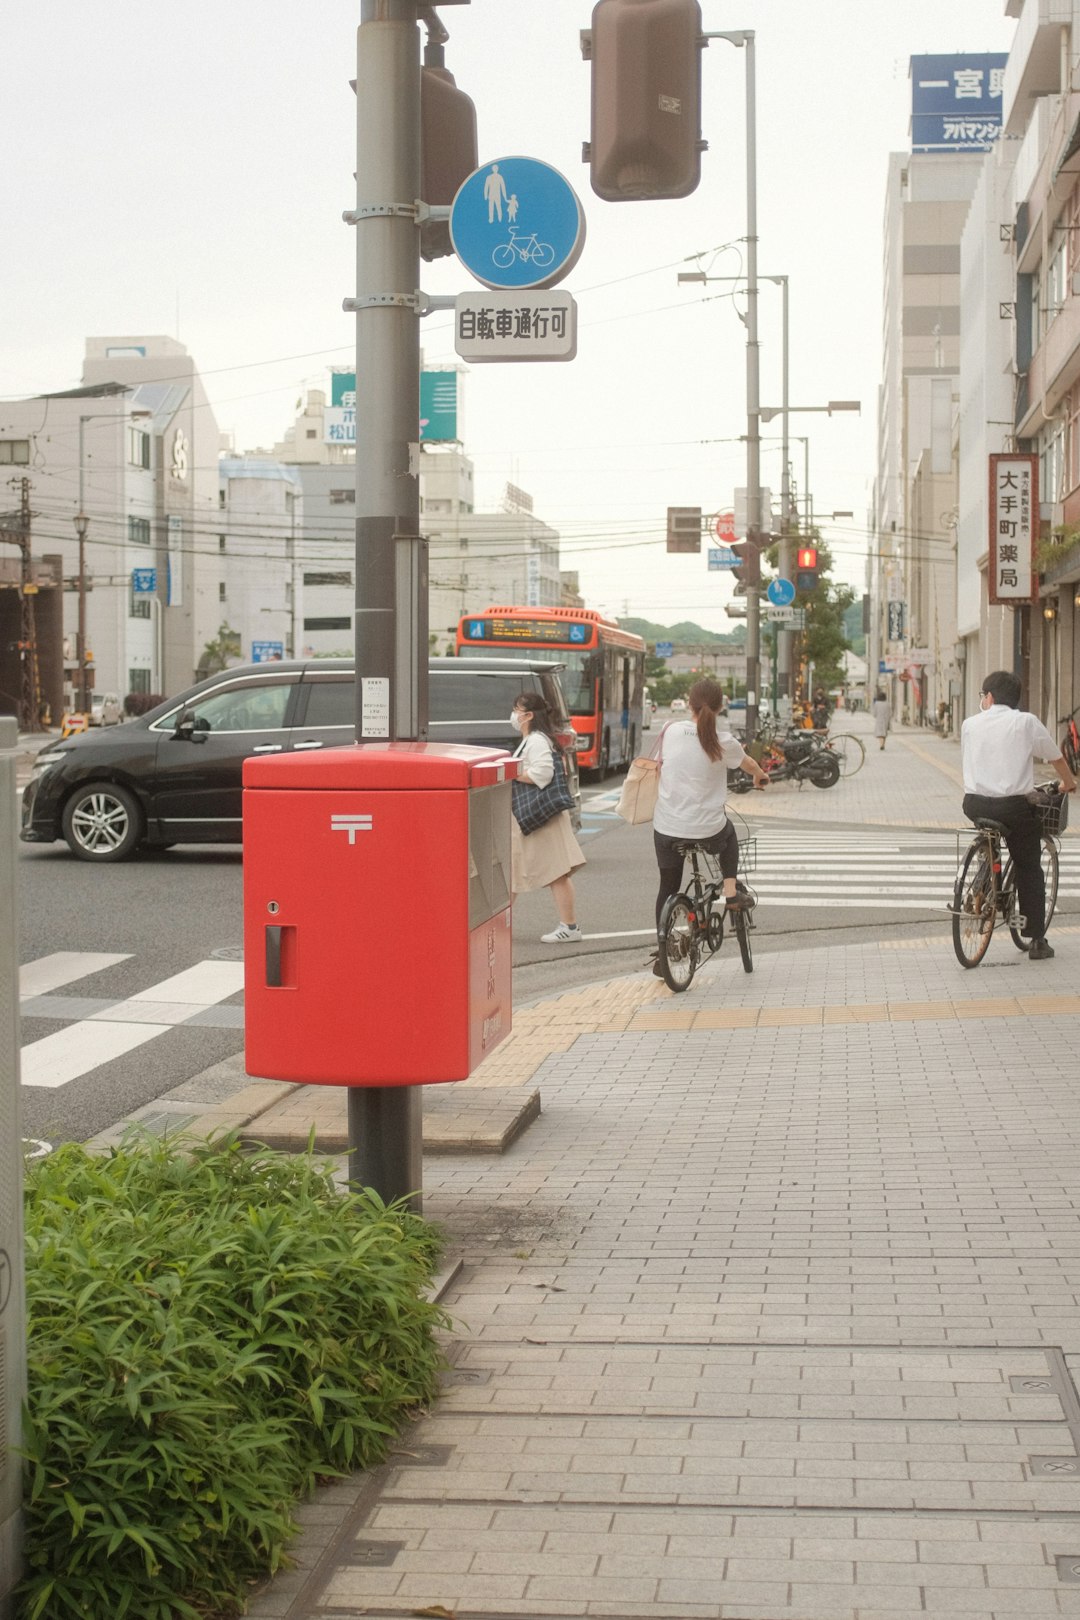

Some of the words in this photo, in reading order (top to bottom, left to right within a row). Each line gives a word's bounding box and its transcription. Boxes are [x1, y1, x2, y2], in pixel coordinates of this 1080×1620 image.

[459, 307, 568, 340] 自転車通行可
[999, 471, 1018, 587] 大手町薬局
